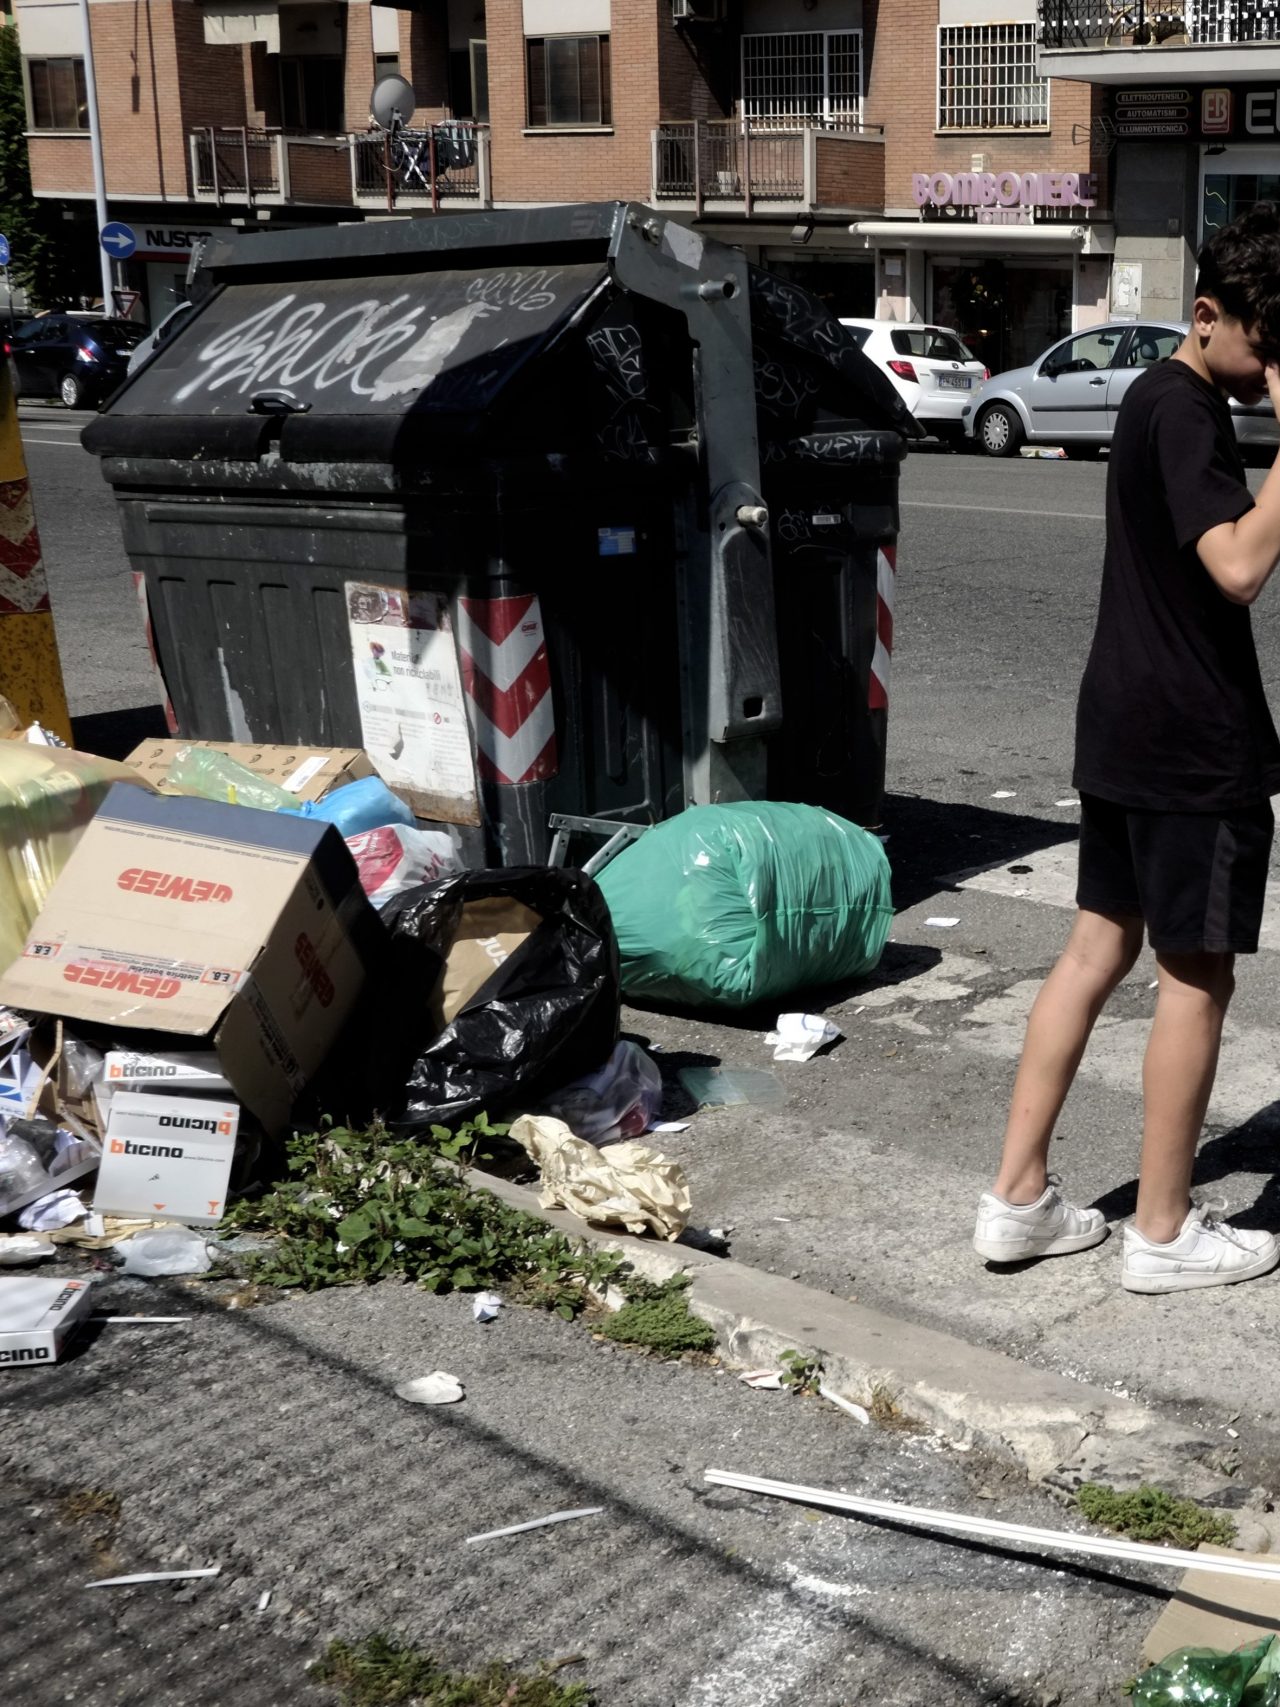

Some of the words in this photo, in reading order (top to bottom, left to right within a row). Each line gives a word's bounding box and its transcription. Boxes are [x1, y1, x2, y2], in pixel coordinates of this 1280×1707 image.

[1121, 93, 1184, 102] ELETTROUTENSILI
[1126, 109, 1177, 117] AUTOMATISMI
[1119, 125, 1183, 133] ILLUMINOTECNICA
[911, 171, 1097, 208] BOMBONIERE
[116, 867, 234, 904] GEWISS
[63, 962, 182, 999] GEWISS
[110, 1064, 177, 1078] bticino
[158, 1115, 232, 1135] bticino
[110, 1138, 183, 1159] bticino
[49, 1281, 85, 1311] bticino
[0, 1347, 49, 1362] cino
